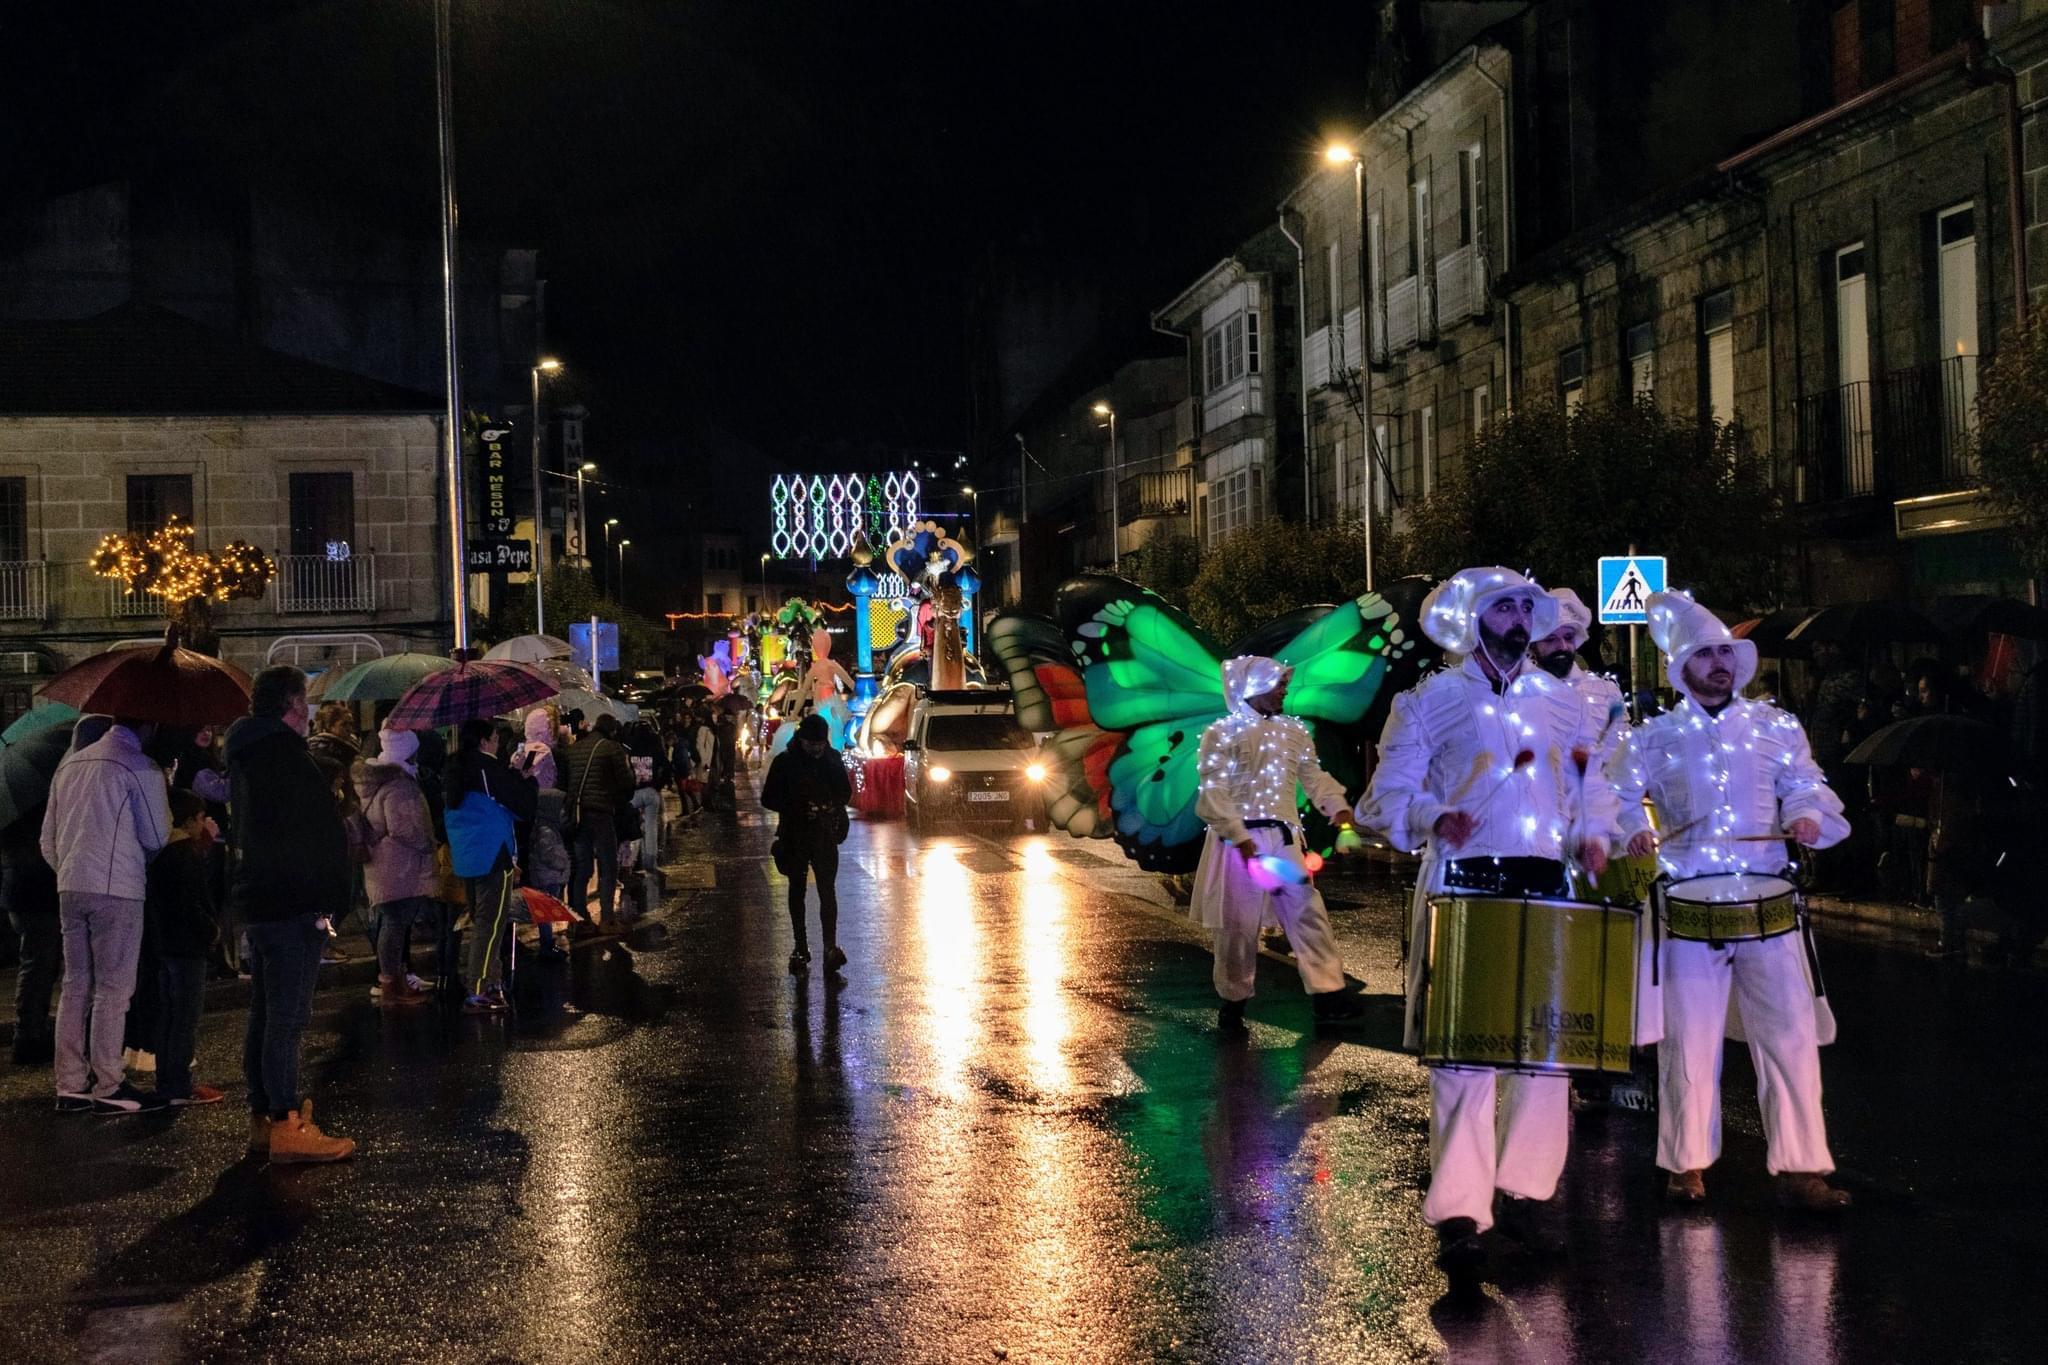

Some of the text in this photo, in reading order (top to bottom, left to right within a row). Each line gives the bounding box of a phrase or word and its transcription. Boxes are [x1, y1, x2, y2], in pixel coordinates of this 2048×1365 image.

[489, 443, 504, 516] BAR MESON
[470, 544, 530, 569] asa Pepe
[974, 792, 992, 801] 2005
